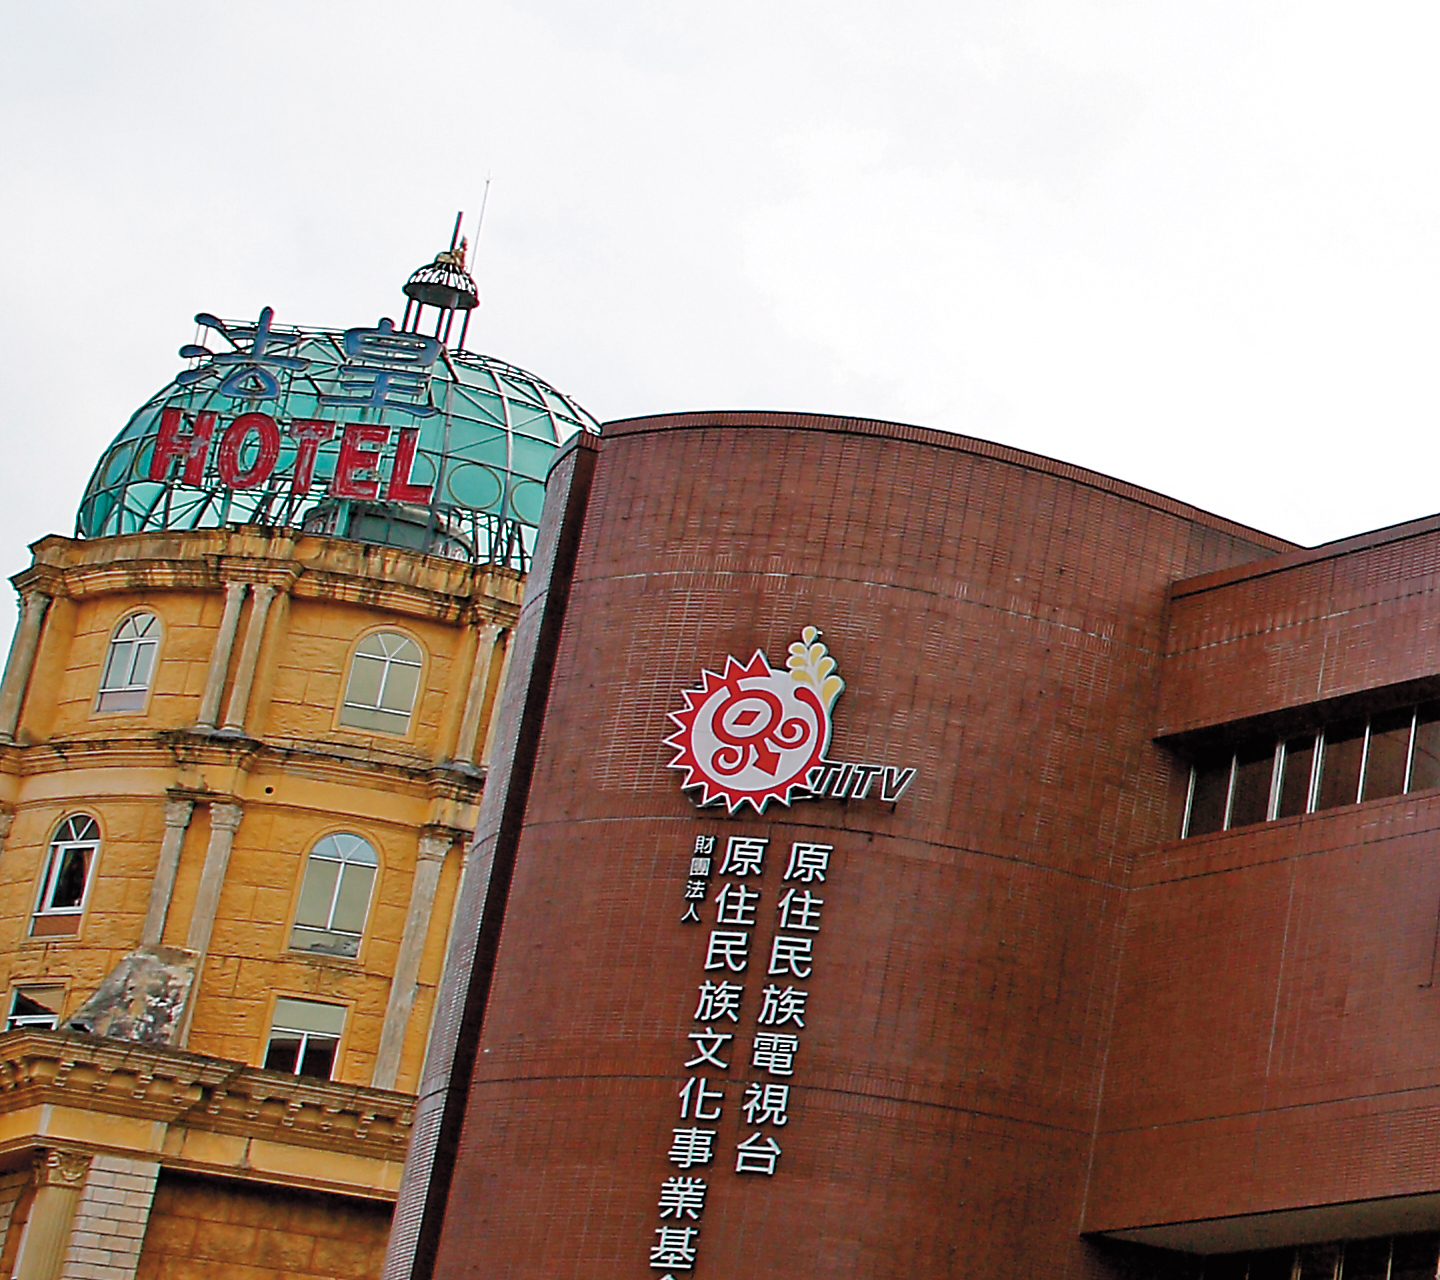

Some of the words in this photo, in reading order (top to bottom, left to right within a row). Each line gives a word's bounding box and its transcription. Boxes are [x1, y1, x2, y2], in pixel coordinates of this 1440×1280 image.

[149, 407, 435, 506] HOTEL
[809, 759, 917, 803] TITV
[735, 842, 834, 1176] 原住民族電視台
